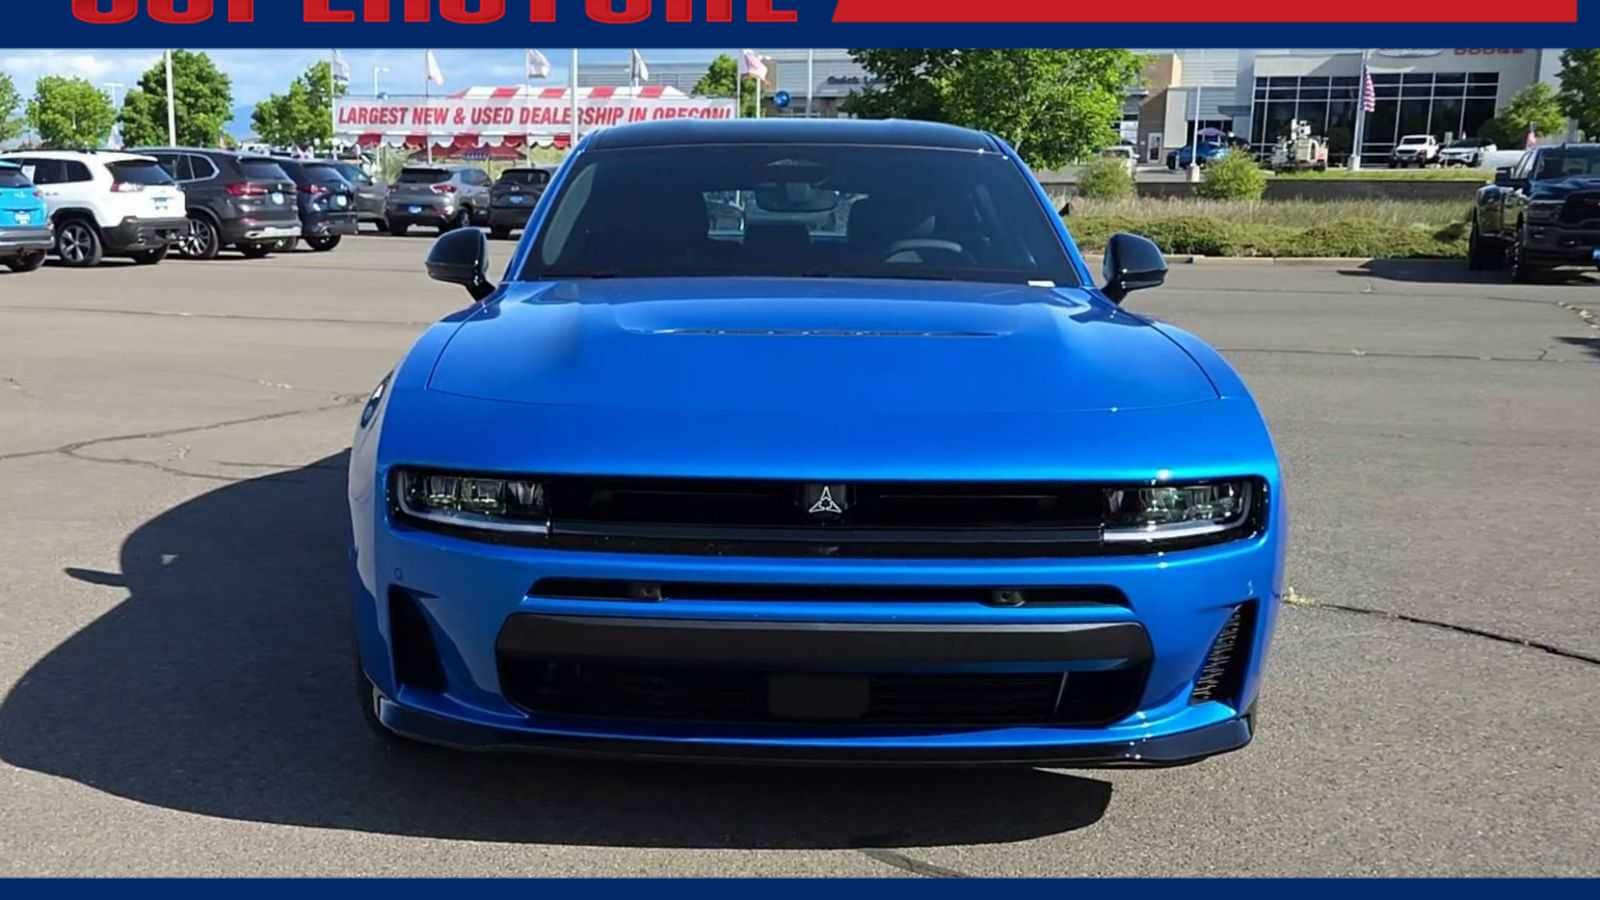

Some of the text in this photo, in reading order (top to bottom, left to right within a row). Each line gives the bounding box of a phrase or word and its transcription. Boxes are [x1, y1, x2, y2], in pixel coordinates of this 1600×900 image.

[338, 107, 408, 125] LARGEST
[412, 107, 449, 125] NEW
[453, 107, 465, 125] &
[471, 107, 514, 125] USED
[519, 107, 624, 126] DEALERSHIP
[628, 107, 648, 122] IN
